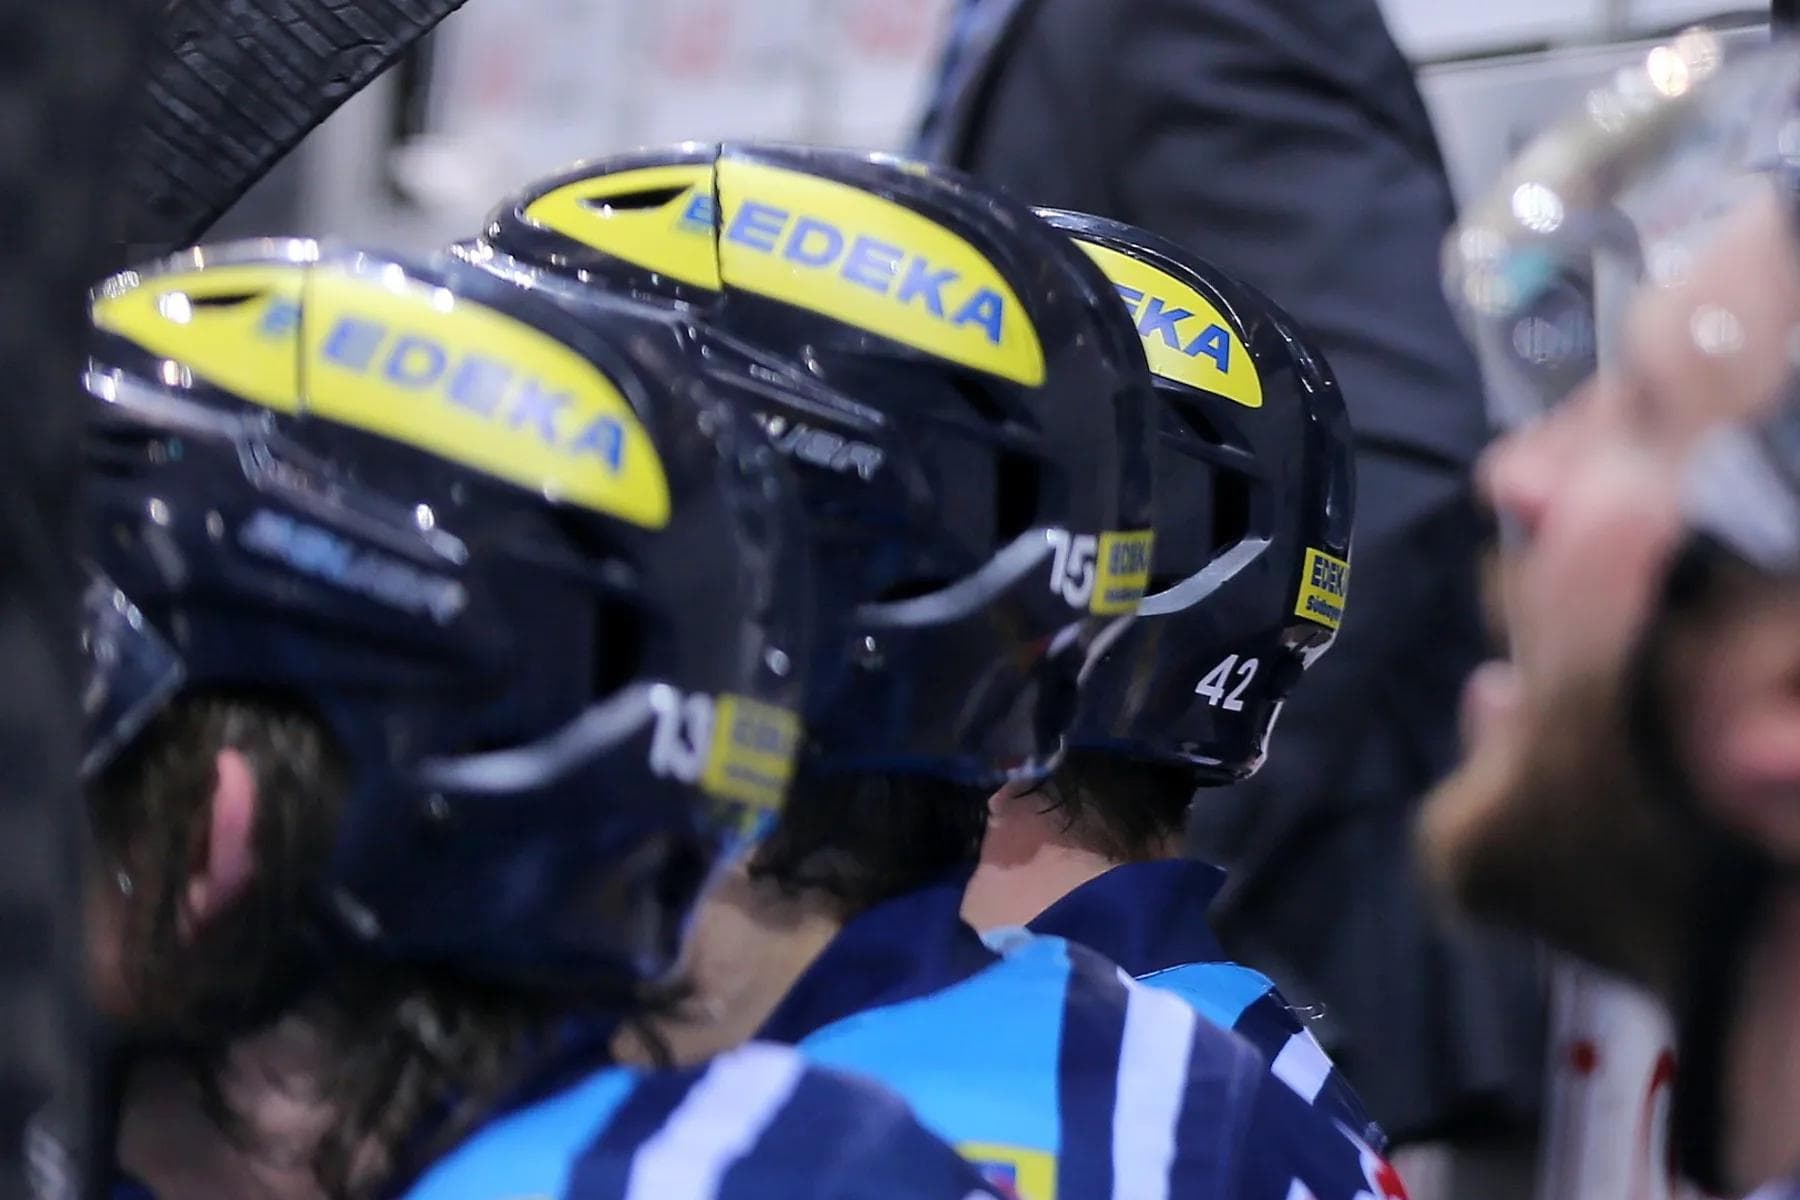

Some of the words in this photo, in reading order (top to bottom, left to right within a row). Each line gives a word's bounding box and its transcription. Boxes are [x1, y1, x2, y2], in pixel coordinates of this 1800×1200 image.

[726, 197, 1004, 346] EDEKA
[321, 315, 626, 476] EDEKA
[1195, 654, 1258, 711] 42
